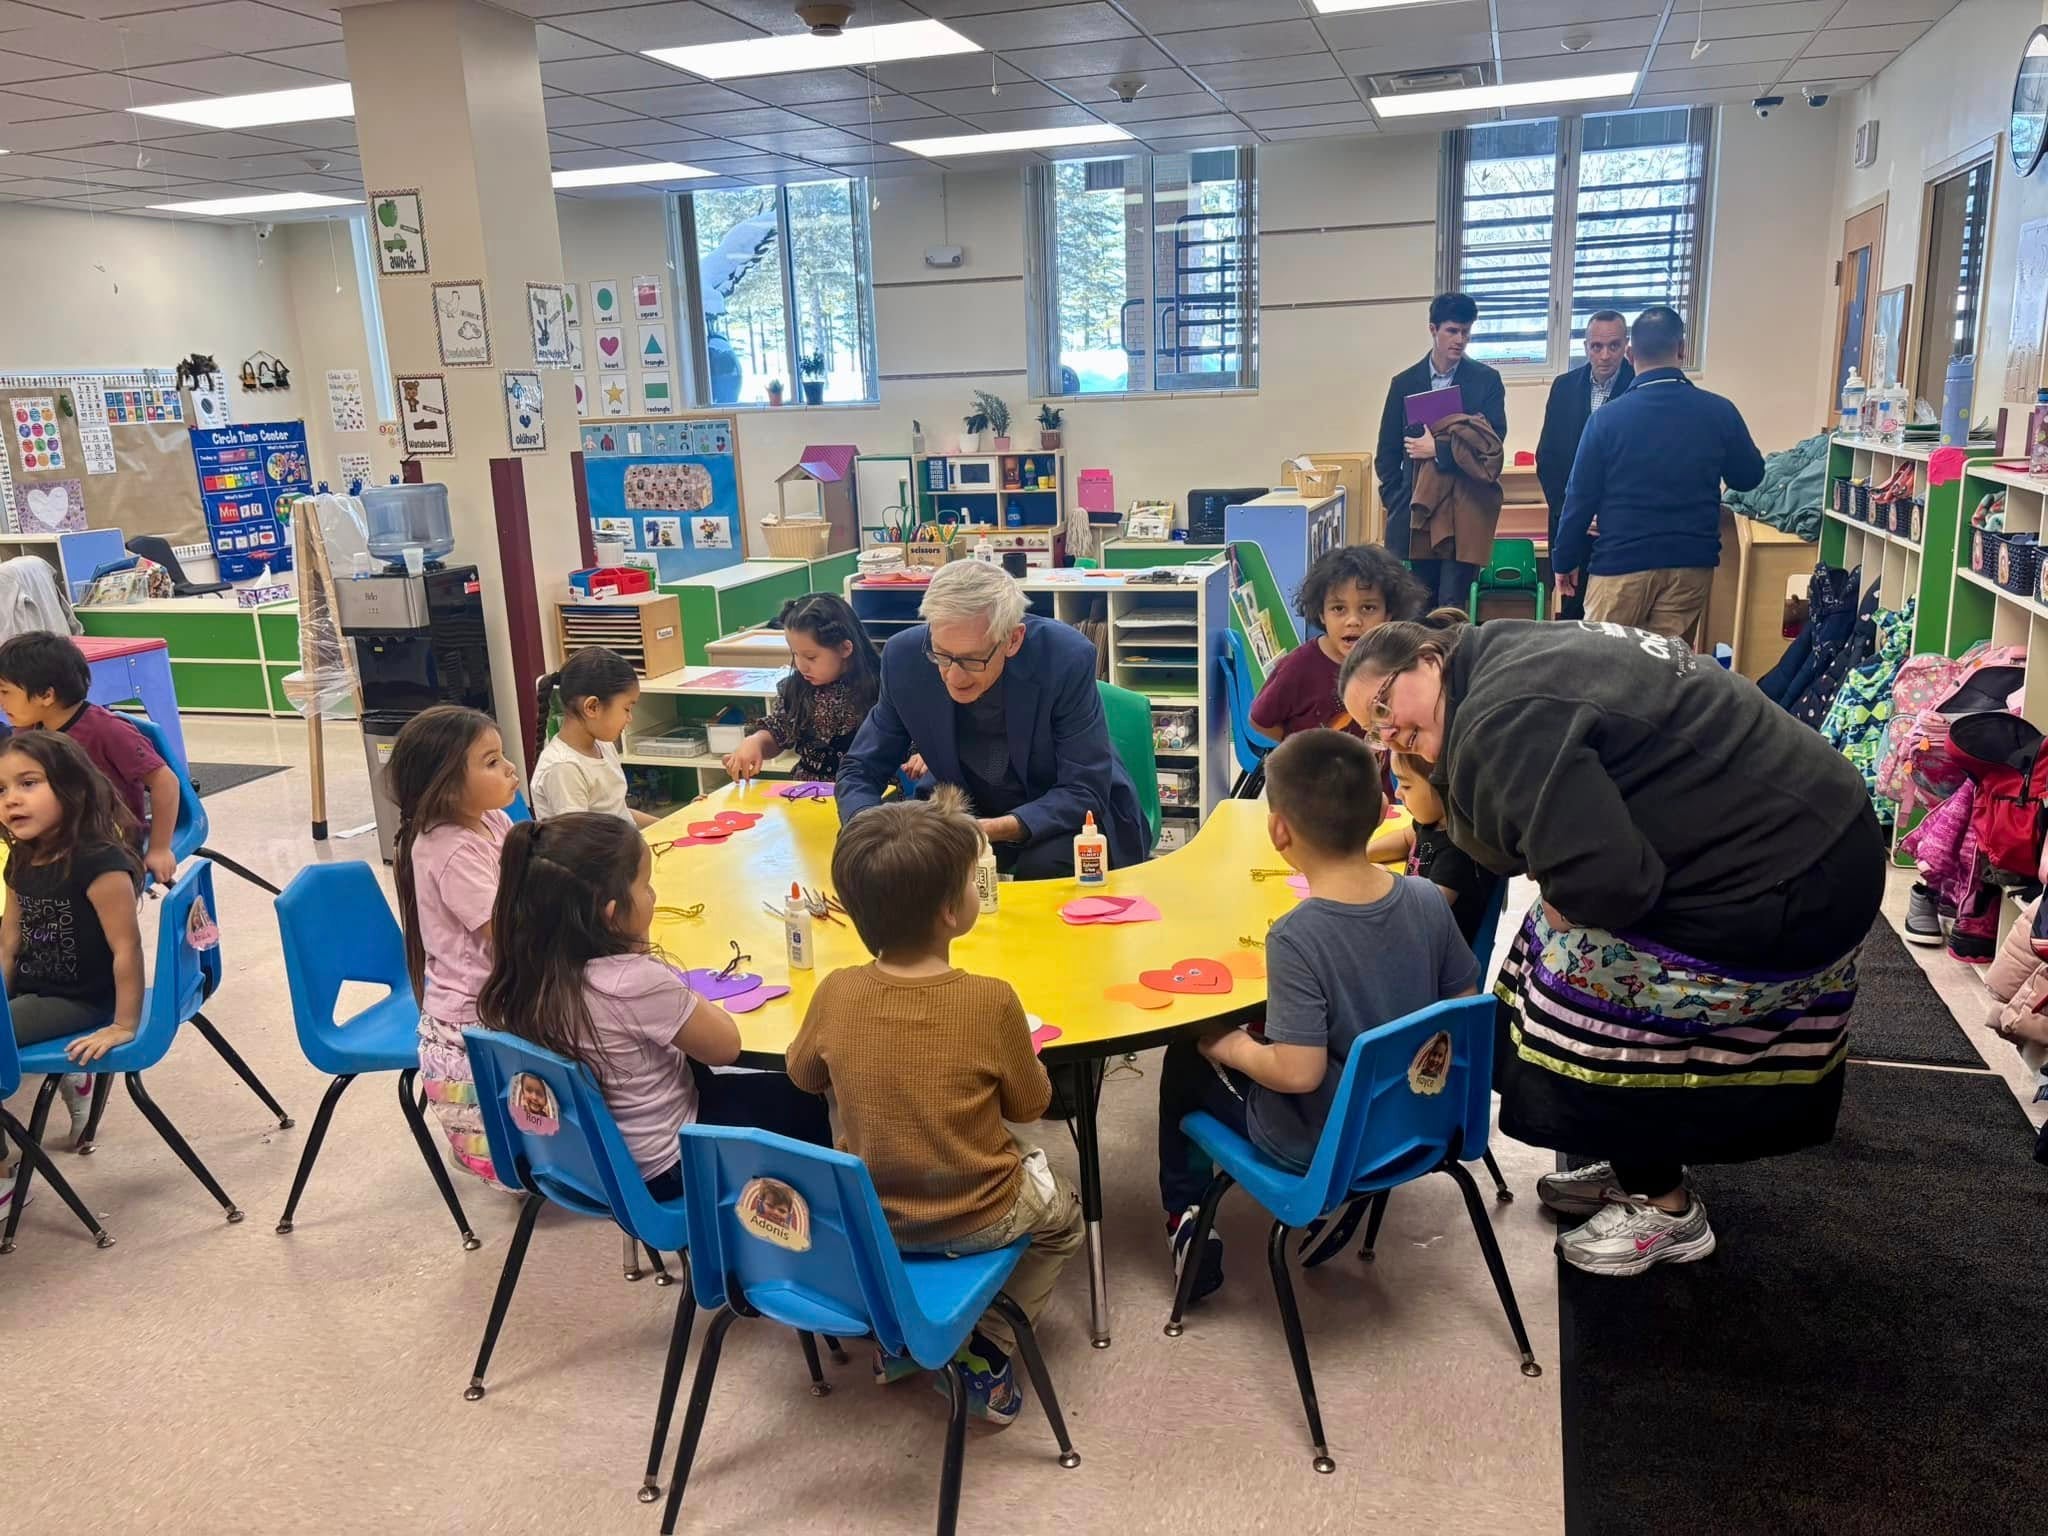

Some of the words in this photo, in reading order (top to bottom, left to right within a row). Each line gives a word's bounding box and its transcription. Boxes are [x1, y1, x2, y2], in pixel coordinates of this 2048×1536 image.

[640, 312, 659, 320] square
[644, 359, 665, 367] triangle
[647, 405, 671, 414] rectangle
[212, 429, 238, 445] Circle
[238, 430, 259, 444] Time
[260, 429, 289, 441] Center
[220, 507, 238, 518] Mm
[910, 546, 941, 554] scissors
[526, 1112, 542, 1127] Rori
[750, 1215, 790, 1241] Adonis
